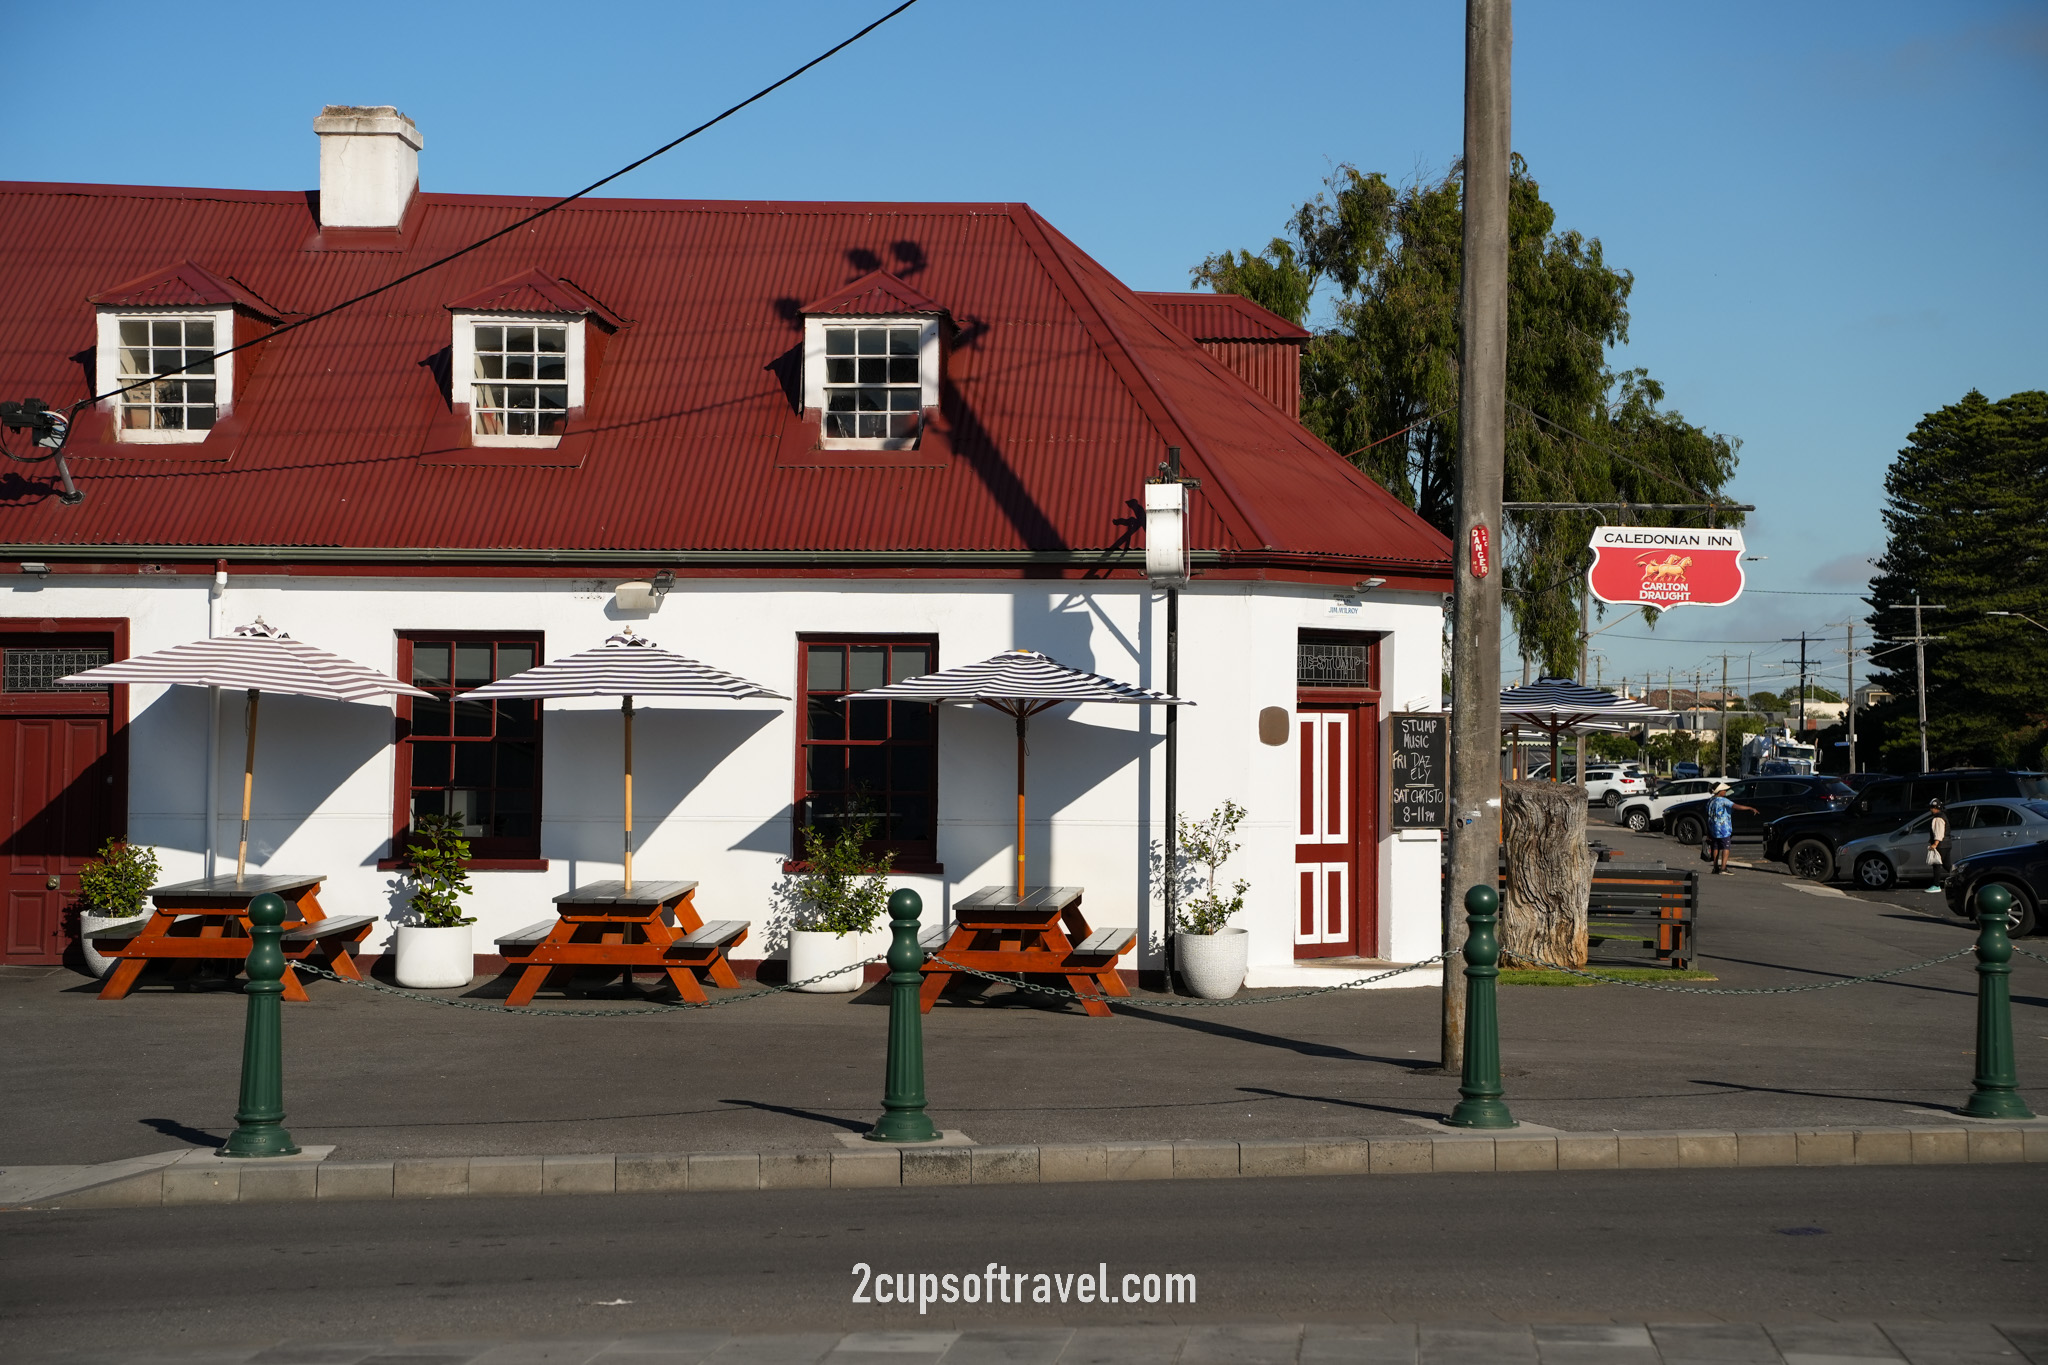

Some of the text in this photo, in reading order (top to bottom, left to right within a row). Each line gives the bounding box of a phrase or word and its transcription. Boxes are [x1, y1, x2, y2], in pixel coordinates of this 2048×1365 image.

[1604, 533, 1732, 546] CALEDONIAN INN
[1642, 581, 1689, 591] CARLTON
[1639, 590, 1691, 601] DRAUGHT
[1401, 719, 1438, 733] STUMP
[1403, 733, 1430, 749] MUSIC
[1392, 750, 1432, 769] FRI DAZ
[1393, 788, 1410, 804] SAT
